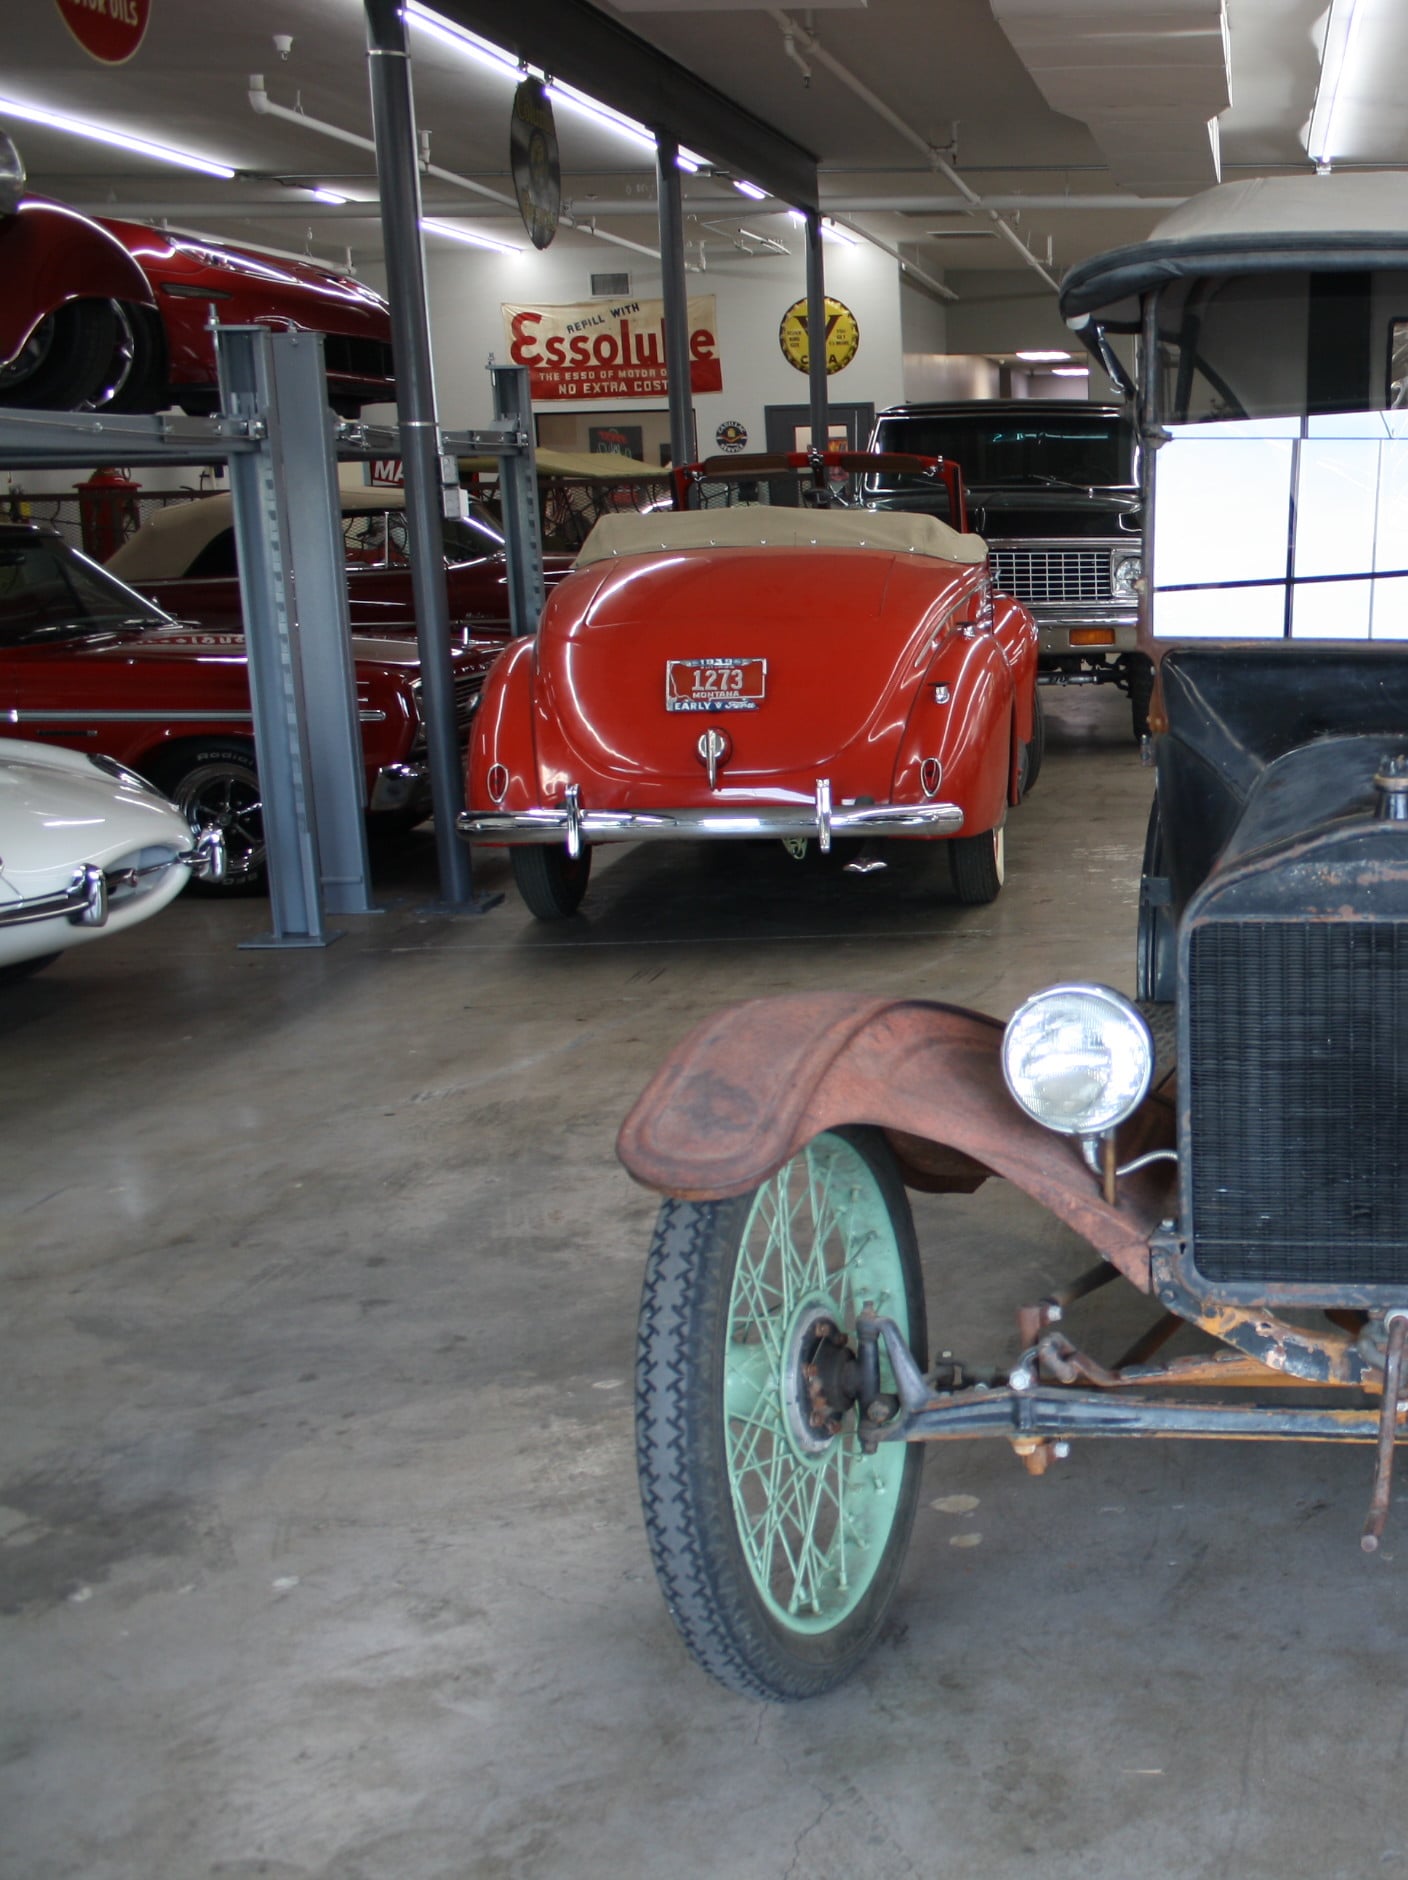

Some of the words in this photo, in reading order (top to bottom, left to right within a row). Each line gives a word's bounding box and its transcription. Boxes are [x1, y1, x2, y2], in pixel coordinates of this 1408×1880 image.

[566, 314, 606, 334] REFILL
[610, 302, 640, 319] WITH
[510, 311, 715, 367] Essolue
[801, 355, 837, 365] CA
[540, 372, 560, 381] THE
[565, 371, 595, 381] ESSO
[600, 370, 614, 379] OF
[618, 369, 656, 378] MOTOR
[558, 383, 577, 395] NO
[583, 382, 628, 394] EXTRA
[634, 380, 668, 392] COST
[692, 669, 743, 691] 1273
[692, 690, 740, 699] MONTANA
[674, 702, 711, 710] EARLY
